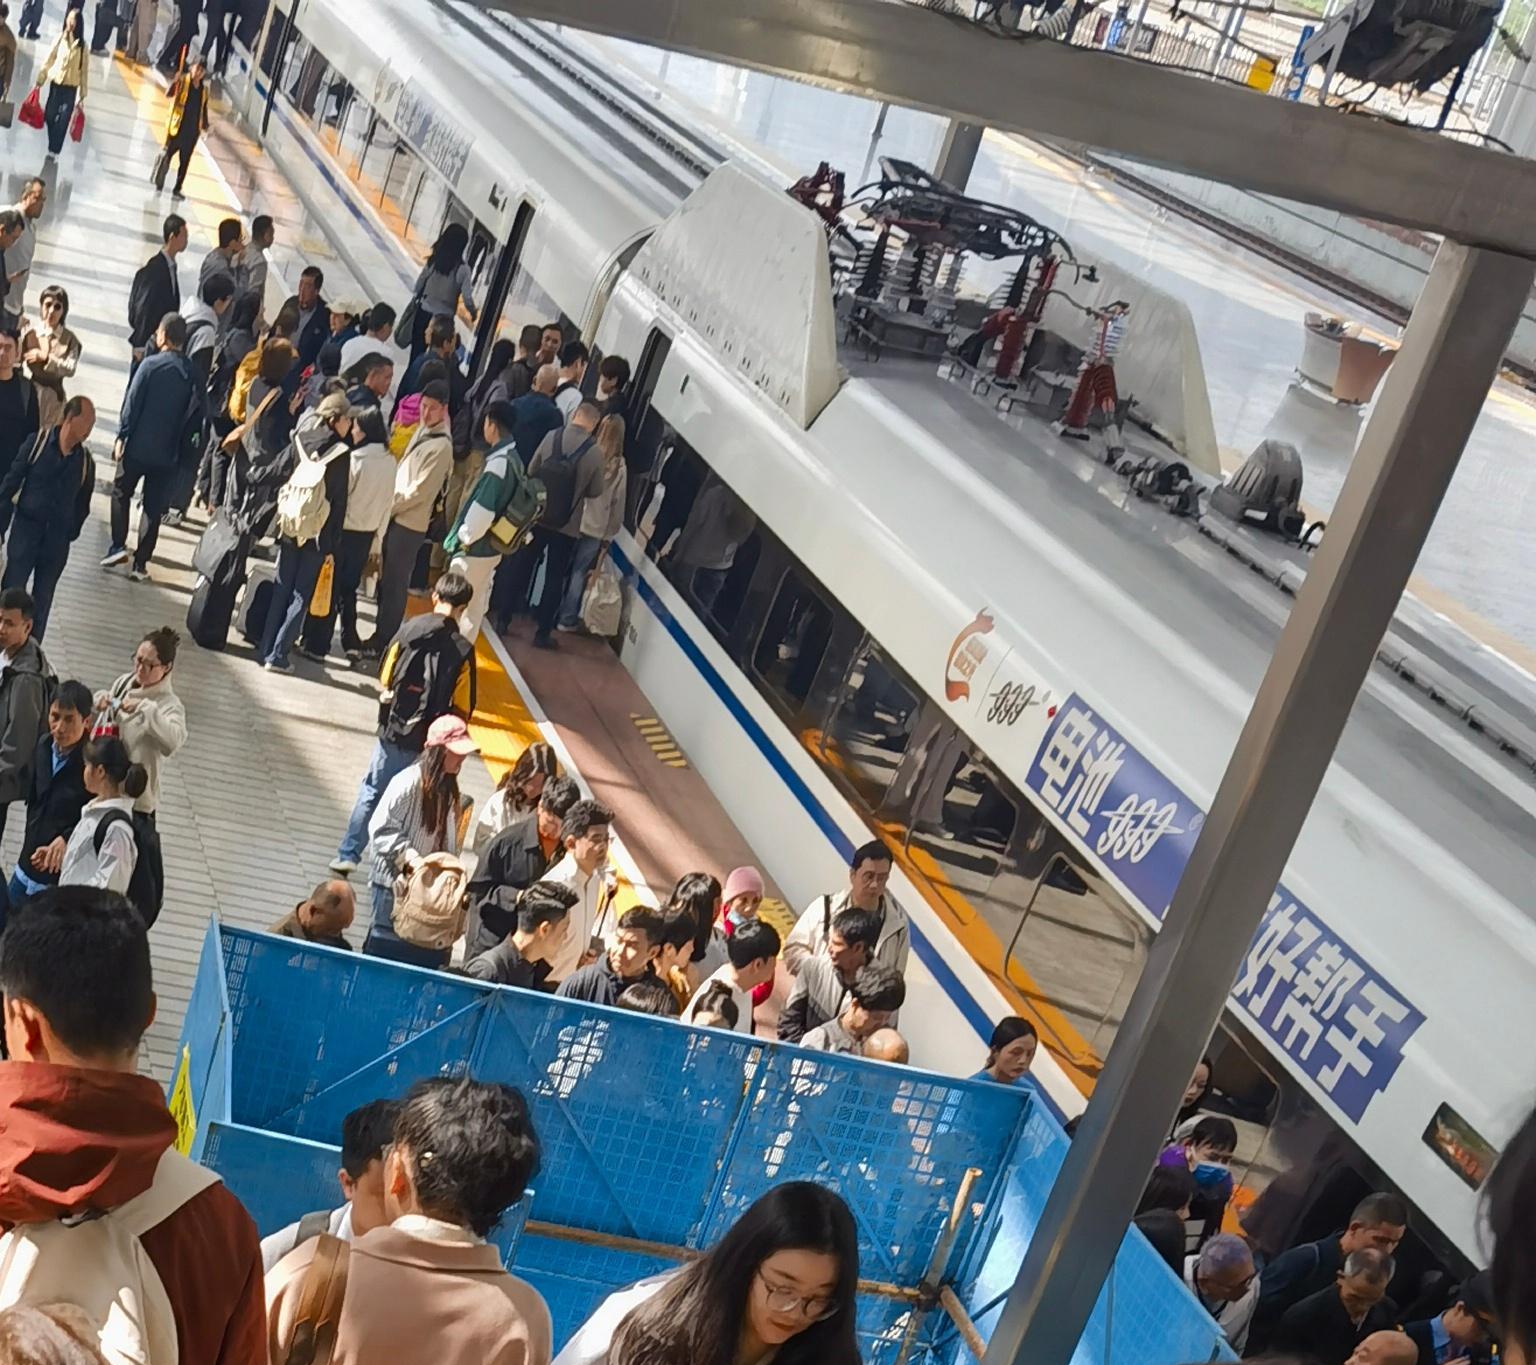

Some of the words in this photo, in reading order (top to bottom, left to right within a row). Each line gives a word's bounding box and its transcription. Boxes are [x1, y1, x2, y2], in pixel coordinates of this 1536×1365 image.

[1039, 707, 1126, 837] 电池
[1231, 892, 1411, 1094] 好帮手
